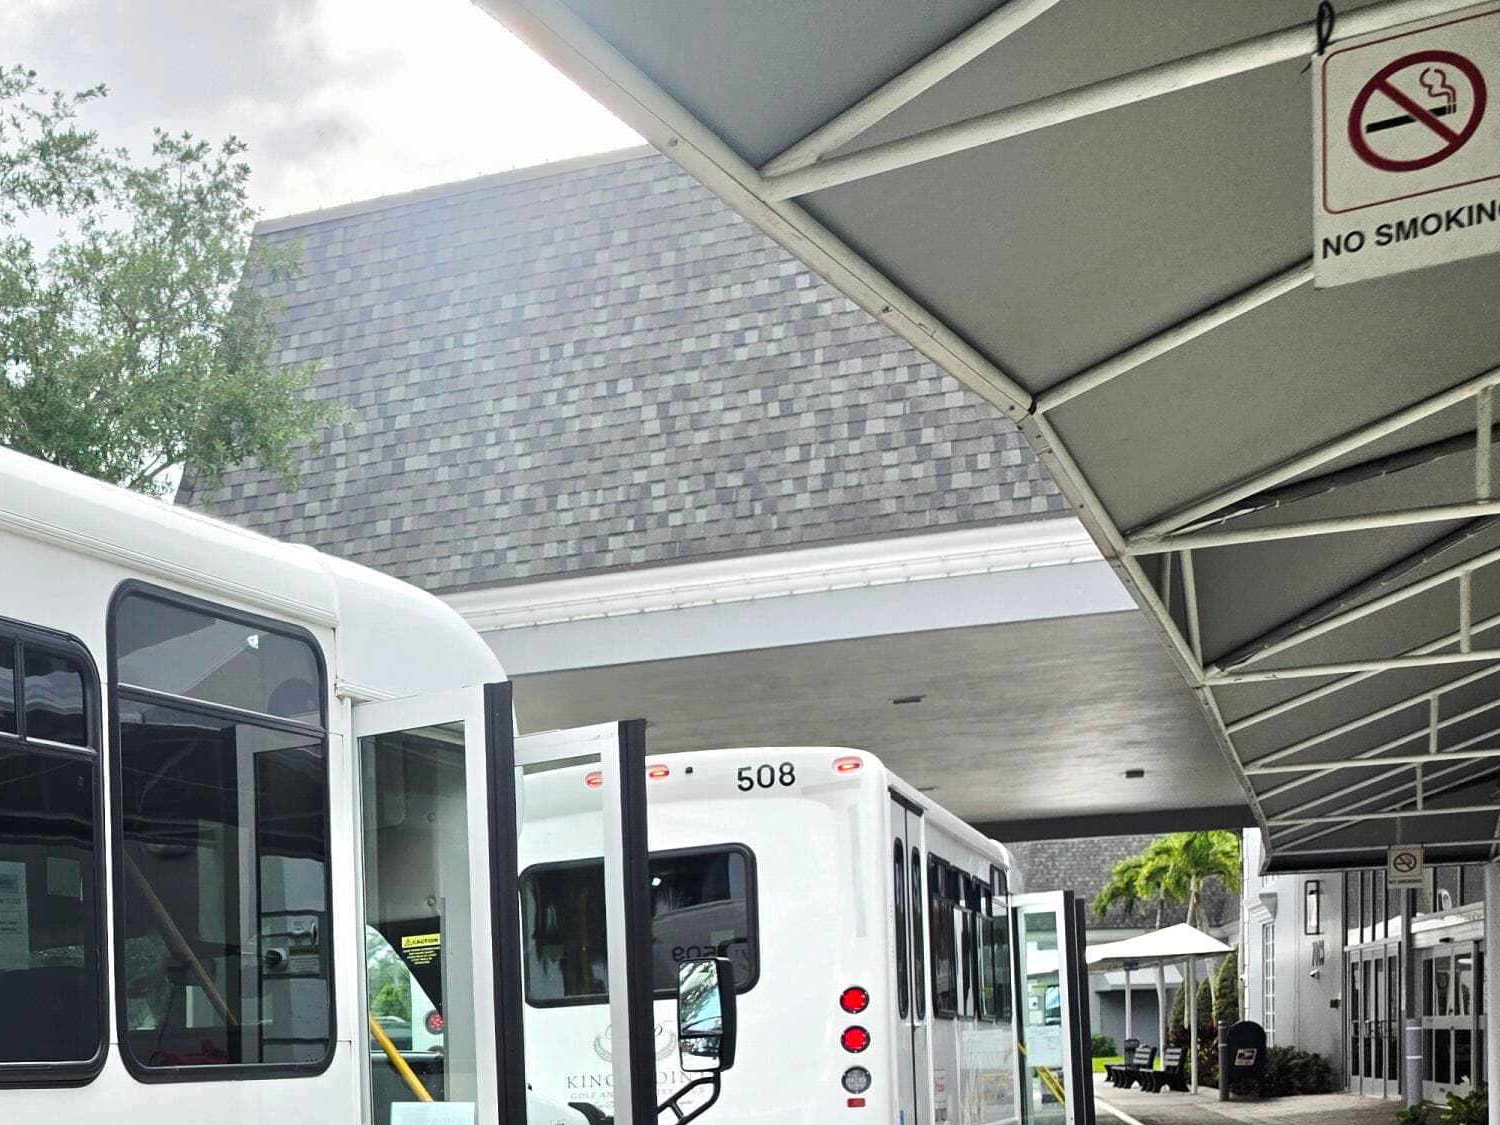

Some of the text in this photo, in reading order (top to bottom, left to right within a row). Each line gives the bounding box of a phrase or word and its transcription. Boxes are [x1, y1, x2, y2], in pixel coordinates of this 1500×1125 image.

[1322, 199, 1500, 259] NO SMOKIN
[737, 761, 796, 792] 508
[567, 1073, 612, 1088] KING
